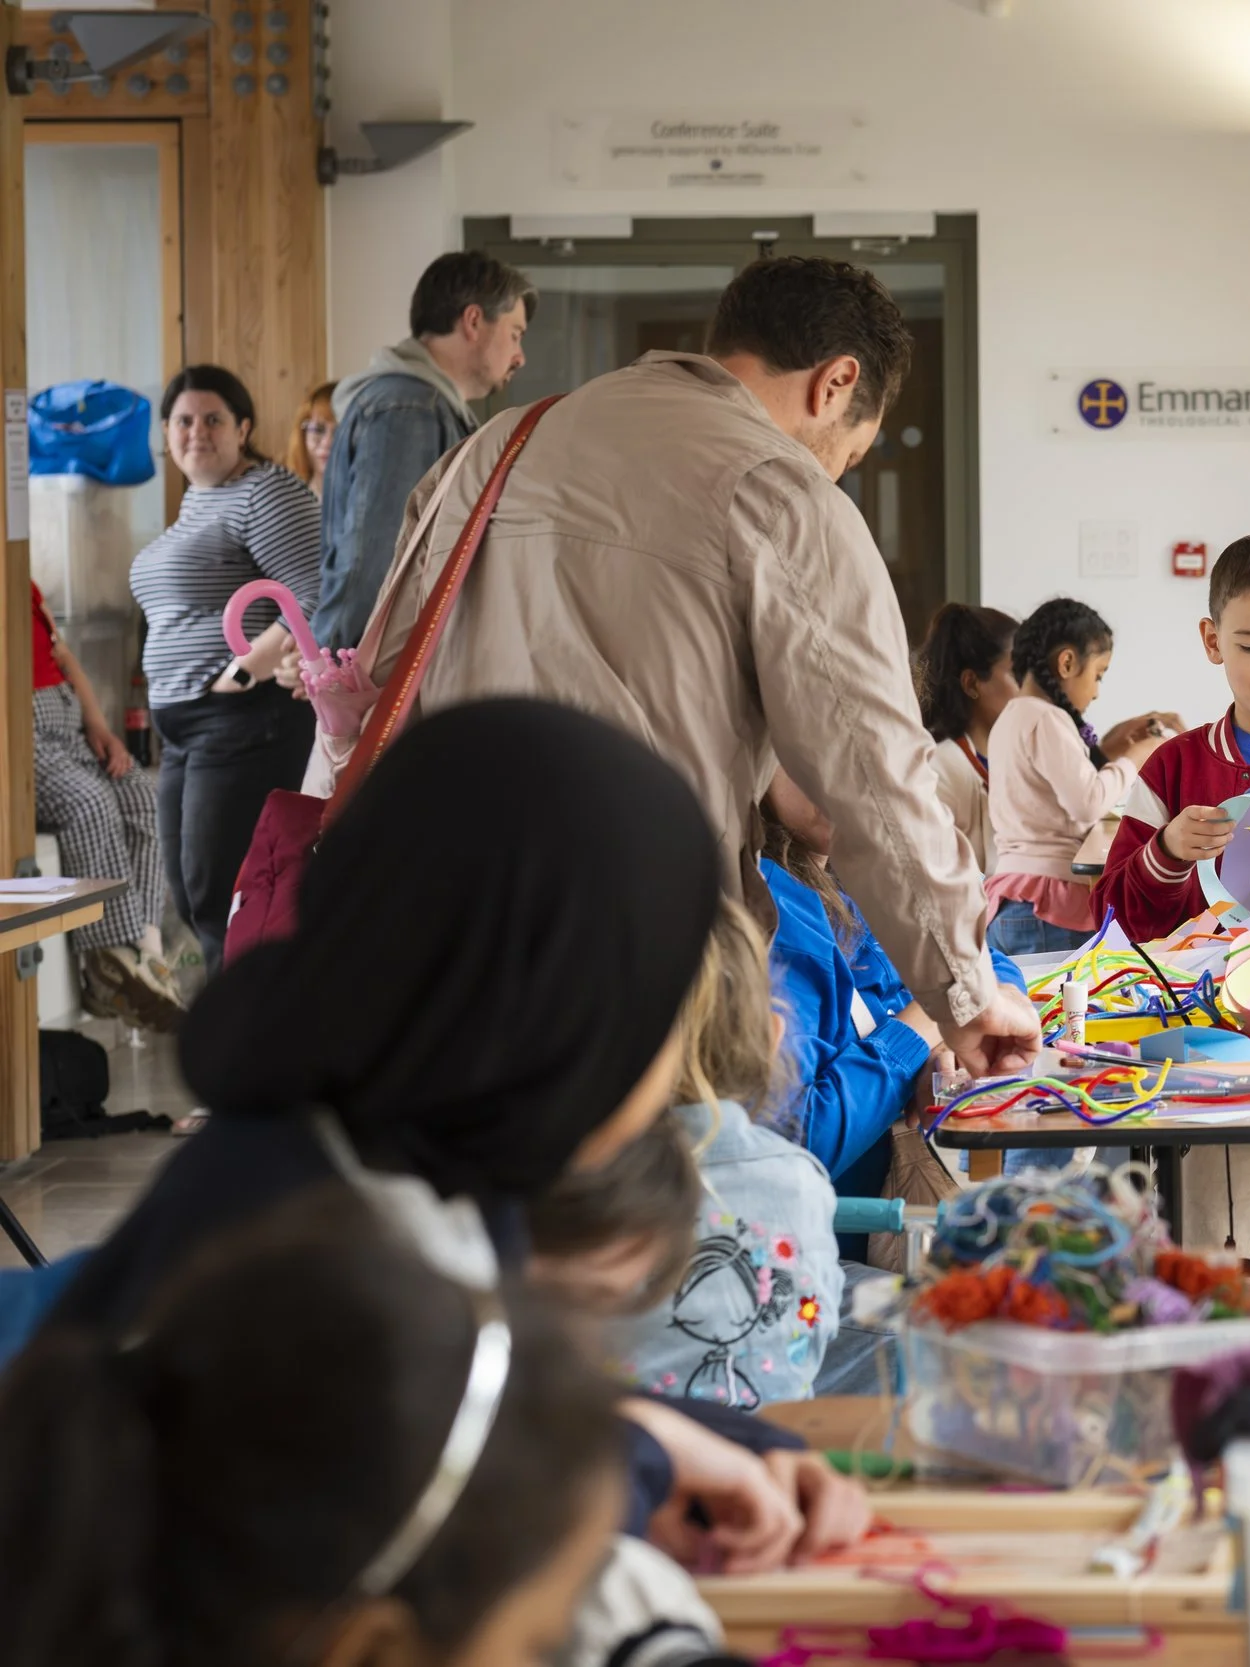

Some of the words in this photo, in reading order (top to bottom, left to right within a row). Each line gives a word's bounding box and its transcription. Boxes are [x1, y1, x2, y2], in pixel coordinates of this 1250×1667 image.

[650, 119, 736, 140] Conference
[741, 119, 779, 140] Suite
[1139, 416, 1240, 427] THEOLOGICAL
